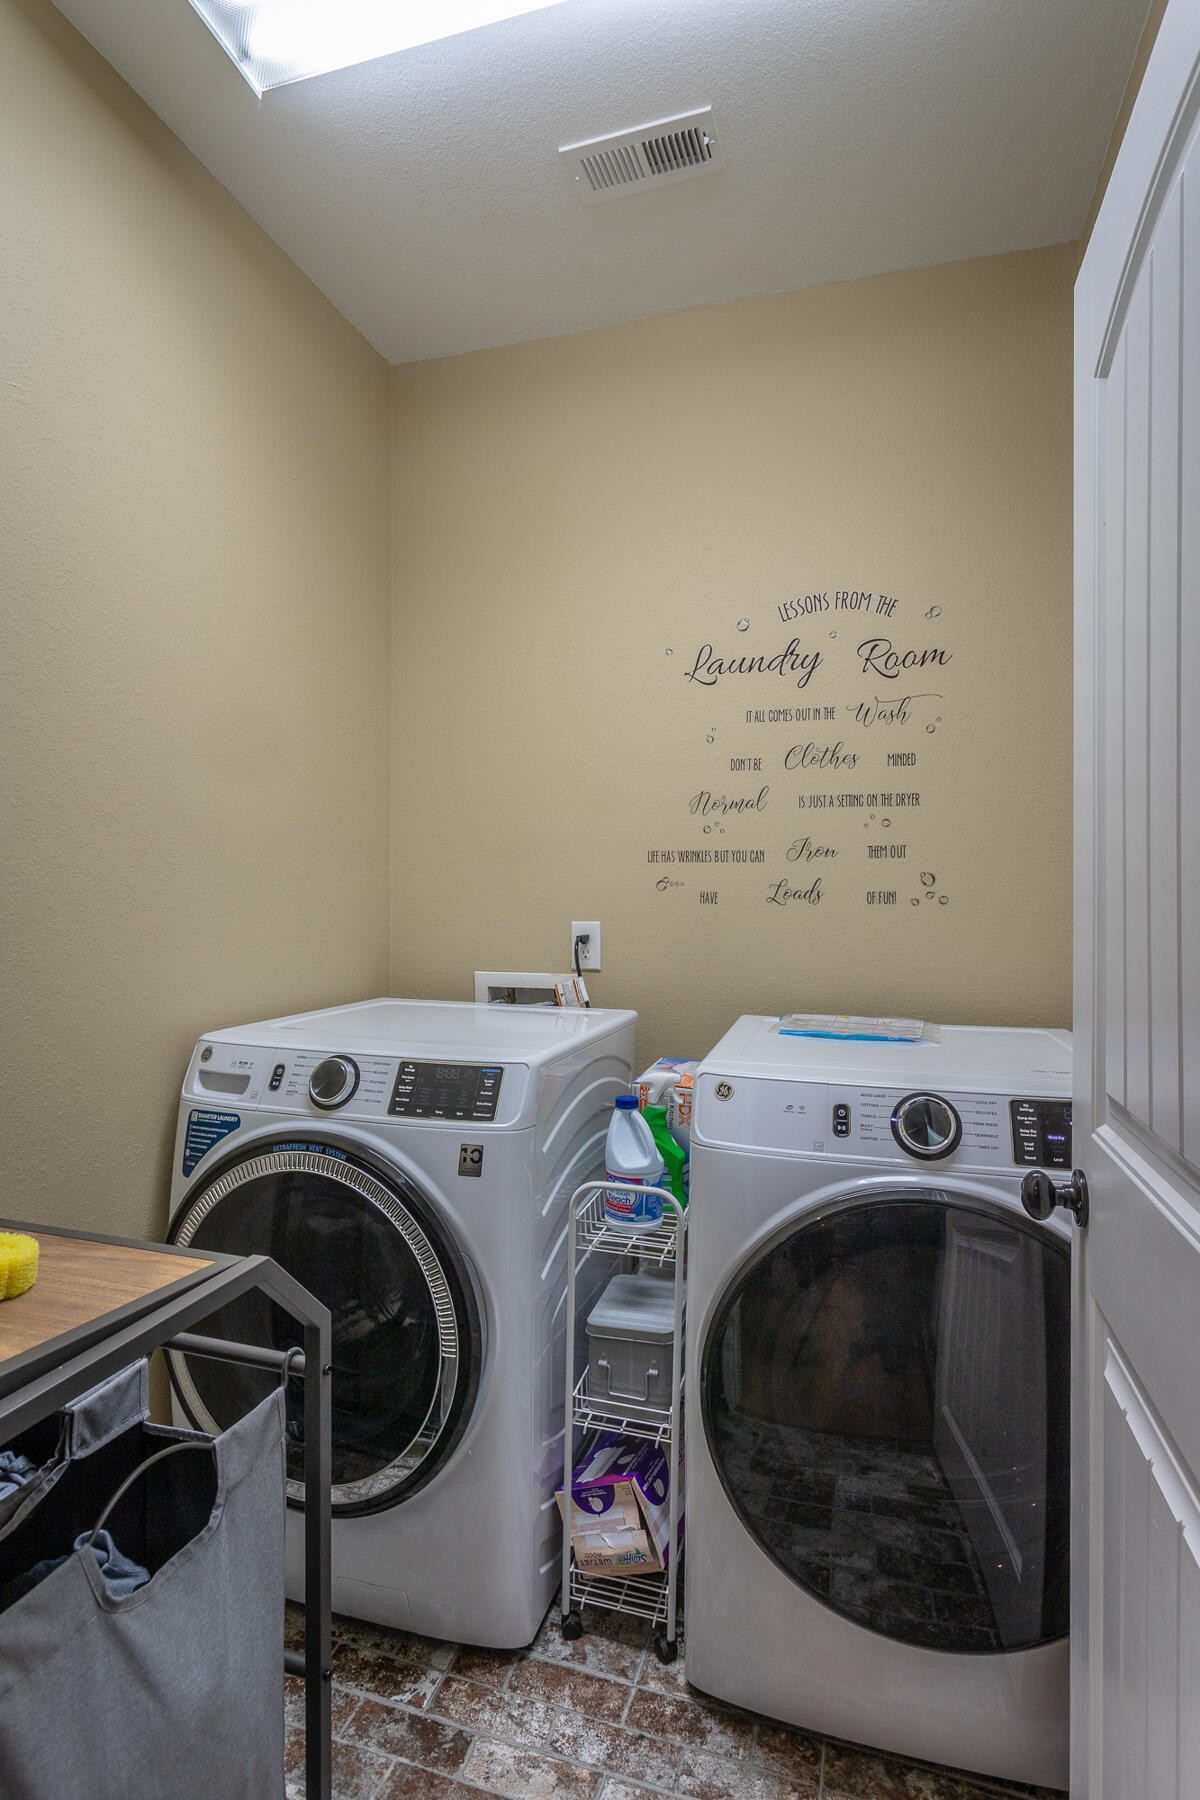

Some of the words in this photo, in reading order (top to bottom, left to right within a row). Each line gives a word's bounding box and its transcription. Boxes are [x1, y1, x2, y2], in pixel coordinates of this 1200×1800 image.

[777, 592, 829, 622] LESSONS
[835, 591, 872, 610] FROM
[875, 595, 898, 617] THE
[684, 637, 824, 688] Laundry
[857, 638, 952, 679] Room
[746, 710, 753, 723] IT
[754, 709, 765, 722] ALL
[768, 708, 793, 722] COMES
[796, 707, 811, 721] OUT
[812, 707, 821, 720] IN
[824, 707, 836, 720] THE
[846, 693, 943, 727] Wash
[730, 758, 752, 771] DON'T
[753, 757, 763, 771] BE
[784, 741, 860, 770] Clothes
[887, 752, 916, 767] MINDED
[689, 785, 769, 816] Normal
[798, 795, 806, 808] IS
[808, 794, 827, 808] JUST
[829, 794, 834, 808] A
[866, 793, 878, 807] ON
[880, 793, 893, 807] THE
[895, 792, 920, 807] DRYER
[647, 850, 659, 863] LIFE
[661, 850, 675, 863] HAS
[677, 850, 712, 863] WRINKLES
[714, 850, 729, 863] BUT
[731, 850, 747, 863] YOU
[749, 849, 765, 863] CAN
[786, 837, 839, 862] Iron
[867, 845, 888, 859] THEM
[890, 844, 907, 859] OUT
[699, 891, 718, 905] HAVE
[766, 877, 825, 906] Loads
[866, 891, 876, 905] OF
[878, 891, 897, 905] FUN!
[678, 1093, 692, 1127] HDX
[616, 1552, 648, 1566] Swiffer
